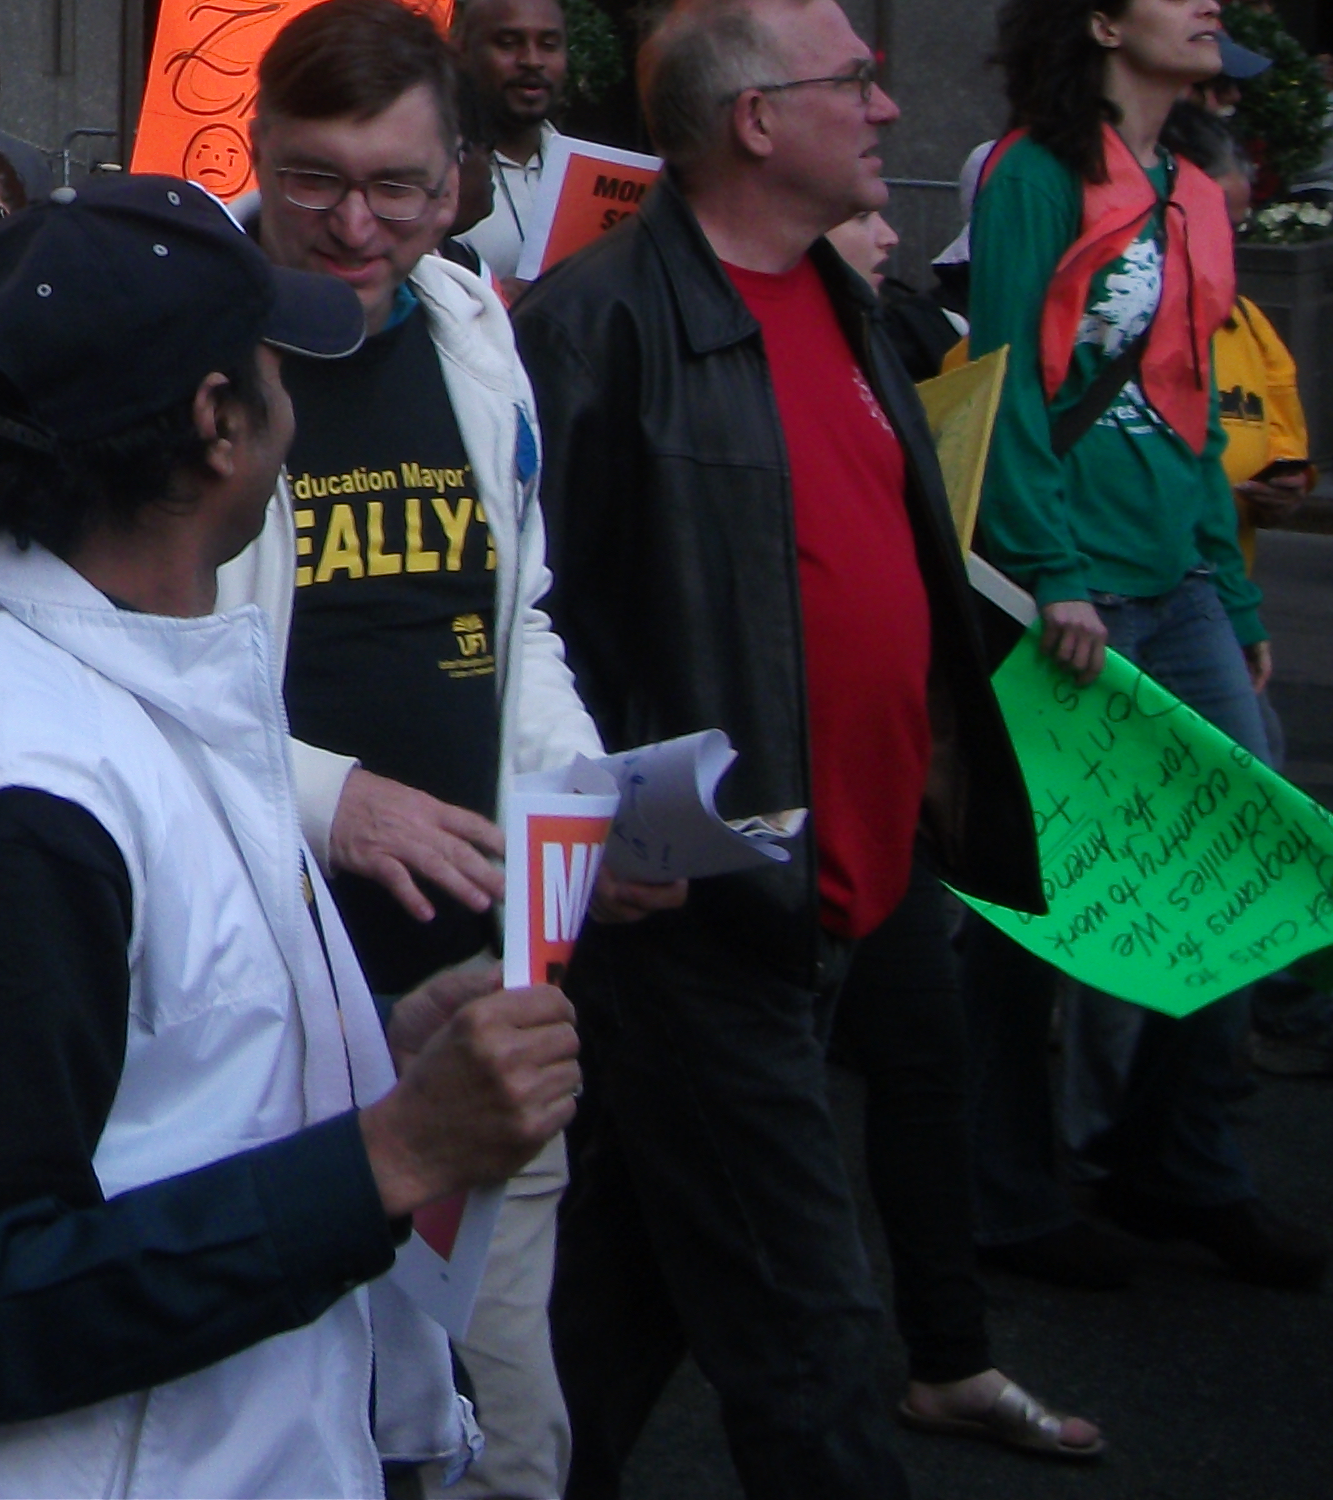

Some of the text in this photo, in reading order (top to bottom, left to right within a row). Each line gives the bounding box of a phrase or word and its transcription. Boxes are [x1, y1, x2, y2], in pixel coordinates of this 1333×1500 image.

[1158, 728, 1202, 788] for
[1108, 883, 1142, 907] to
[1045, 902, 1110, 960] work
[1110, 910, 1171, 959] We
[1165, 937, 1205, 971] for
